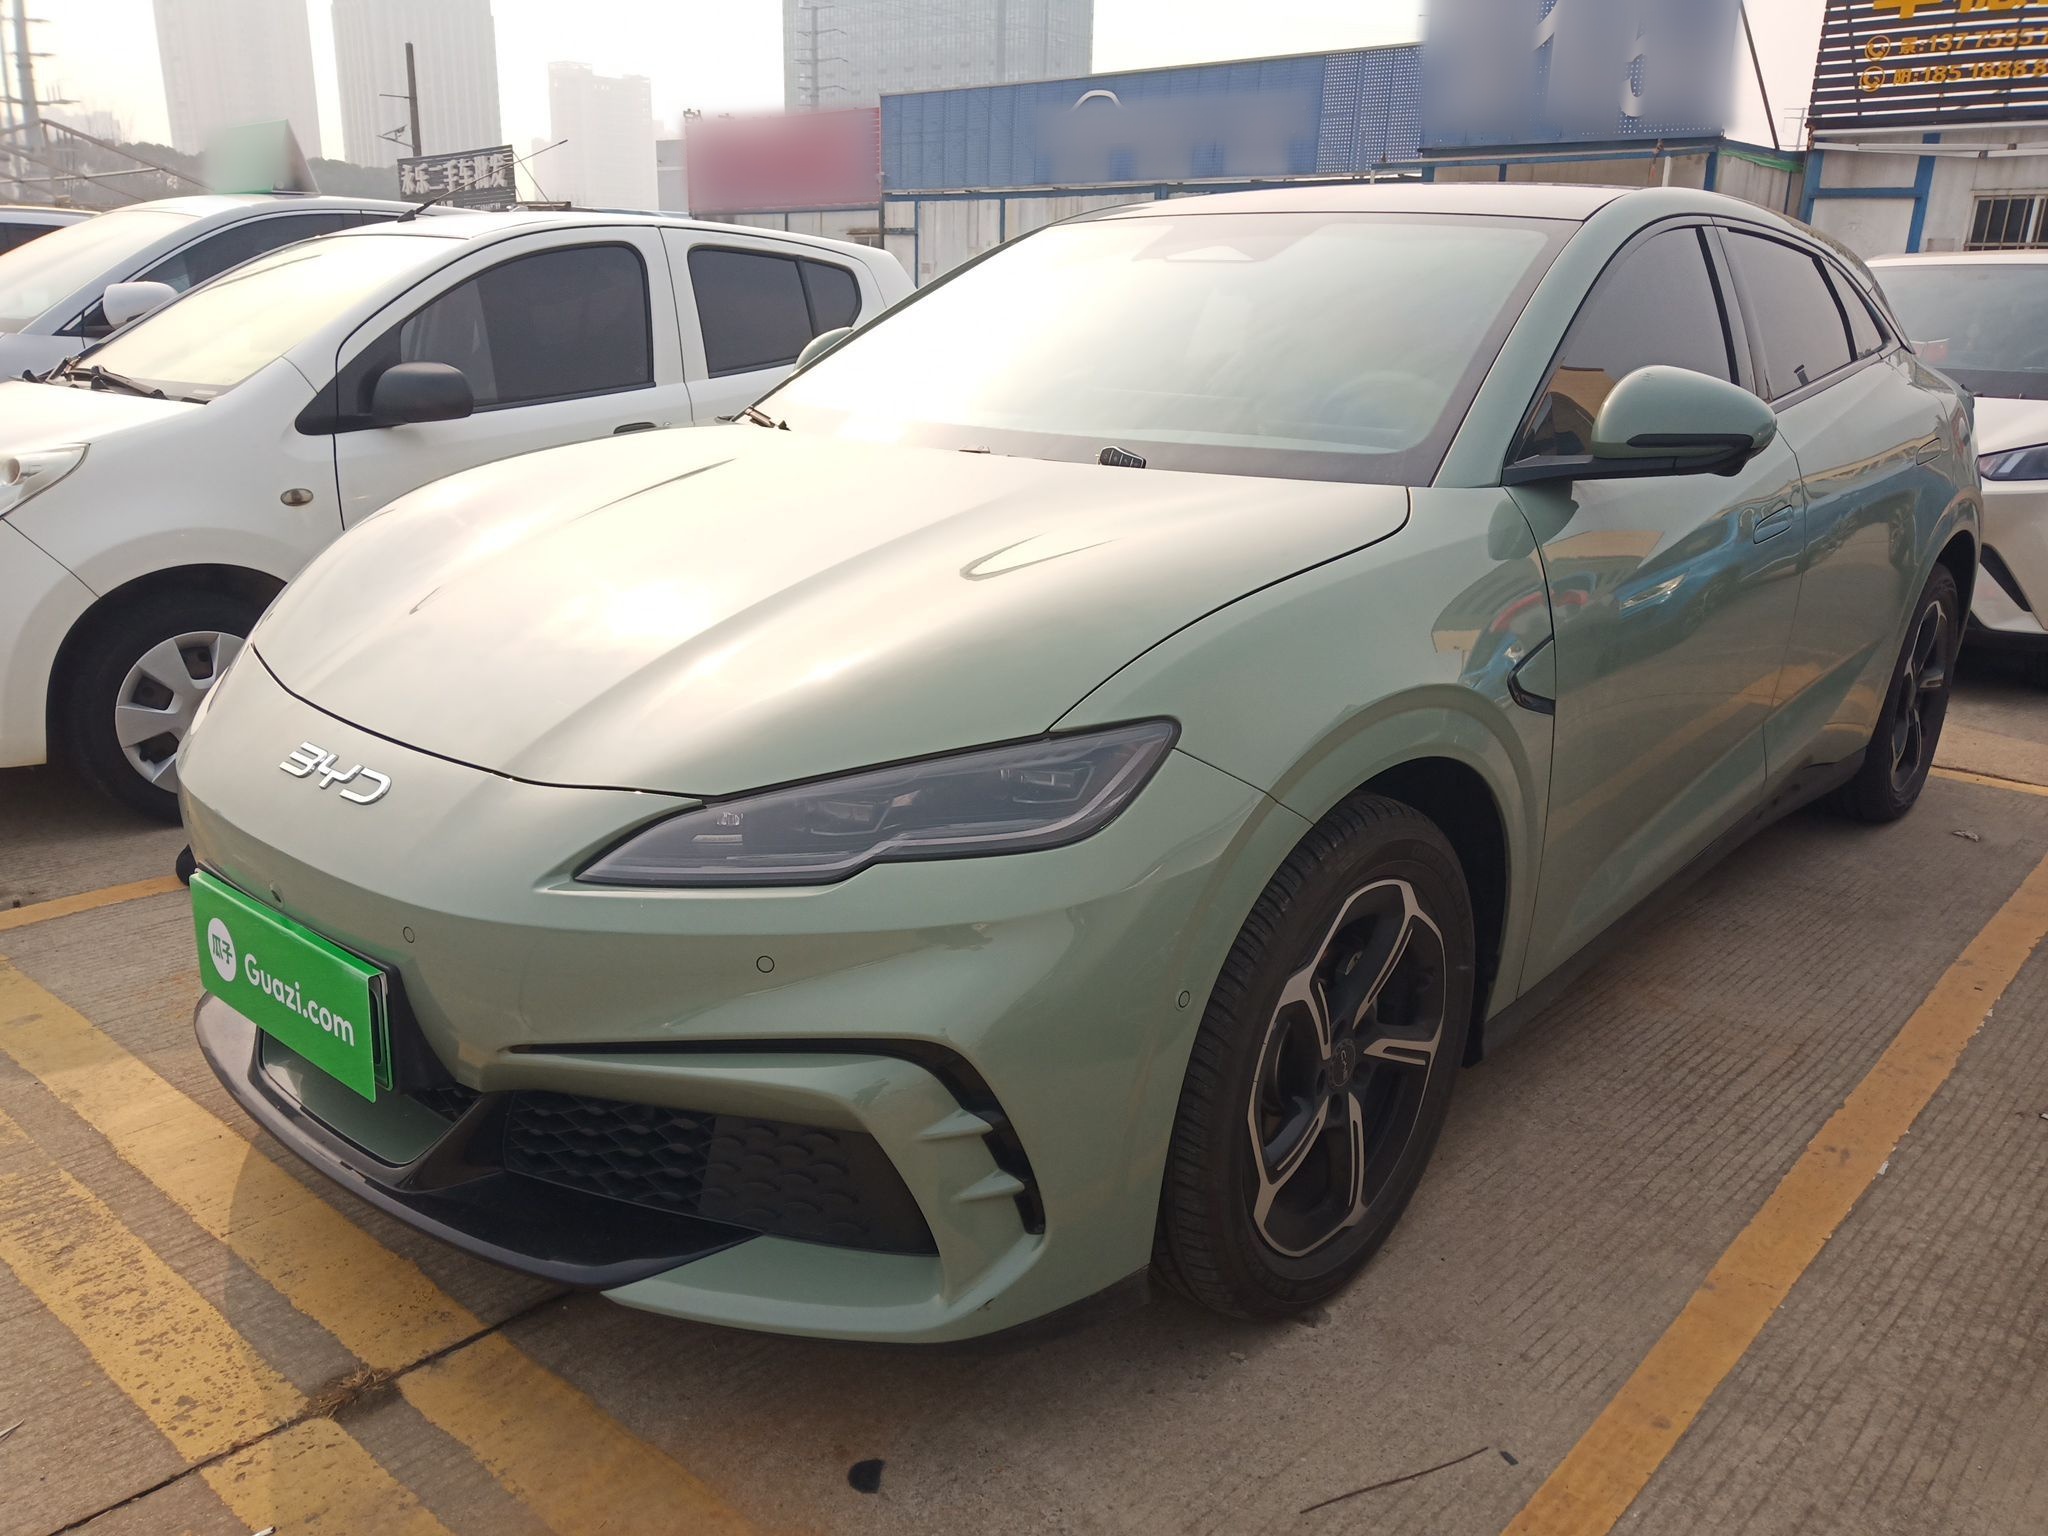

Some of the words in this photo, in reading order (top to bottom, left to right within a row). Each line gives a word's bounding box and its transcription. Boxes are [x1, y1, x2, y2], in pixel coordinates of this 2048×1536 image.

[279, 741, 392, 806] BYD
[212, 934, 233, 965] 瓜子
[244, 953, 355, 1047] Guazi.com
